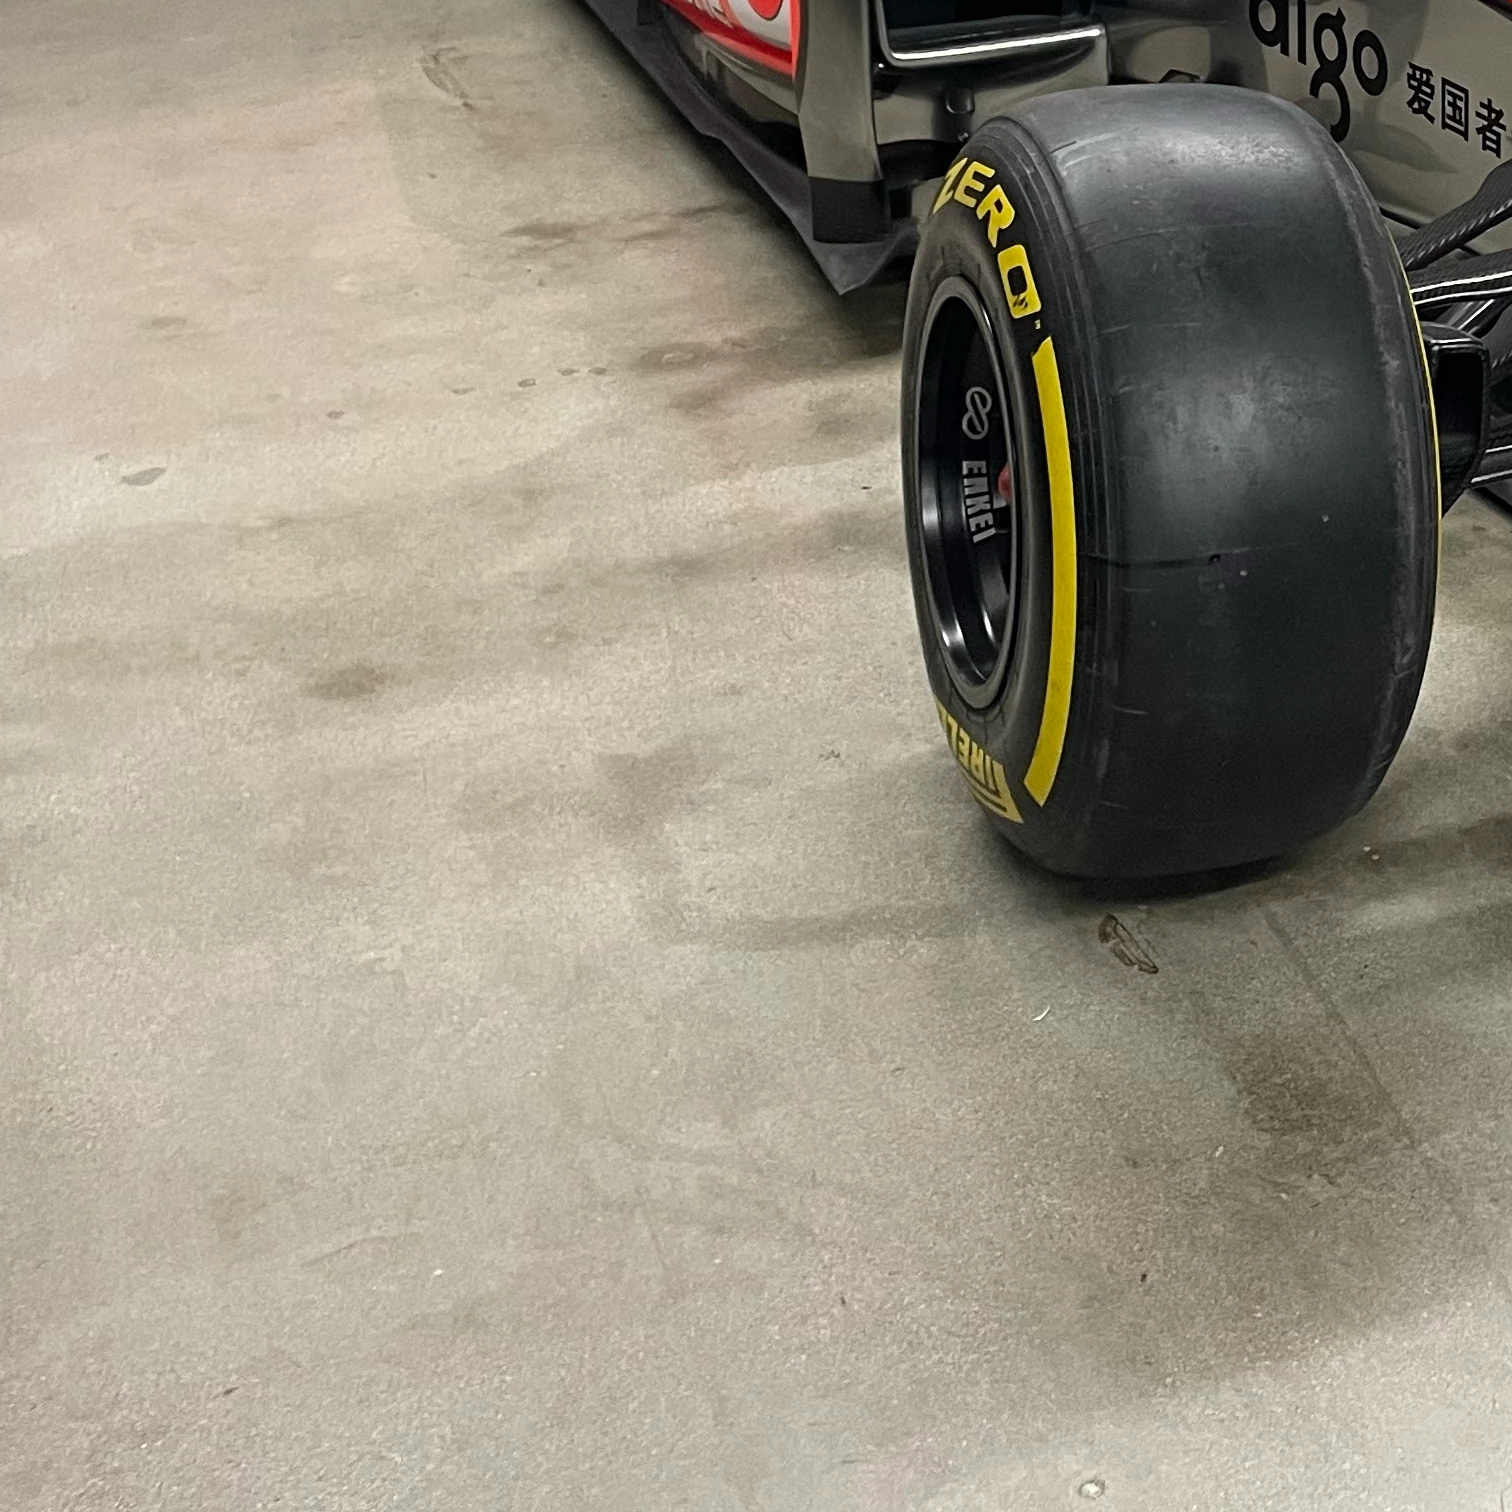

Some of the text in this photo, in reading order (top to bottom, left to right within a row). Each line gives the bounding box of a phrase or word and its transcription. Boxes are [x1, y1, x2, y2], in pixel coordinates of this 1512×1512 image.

[1406, 61, 1507, 160] 爱国者
[932, 157, 1042, 319] ZERO
[962, 460, 996, 543] ENKEI
[936, 700, 1024, 824] PIRELL
